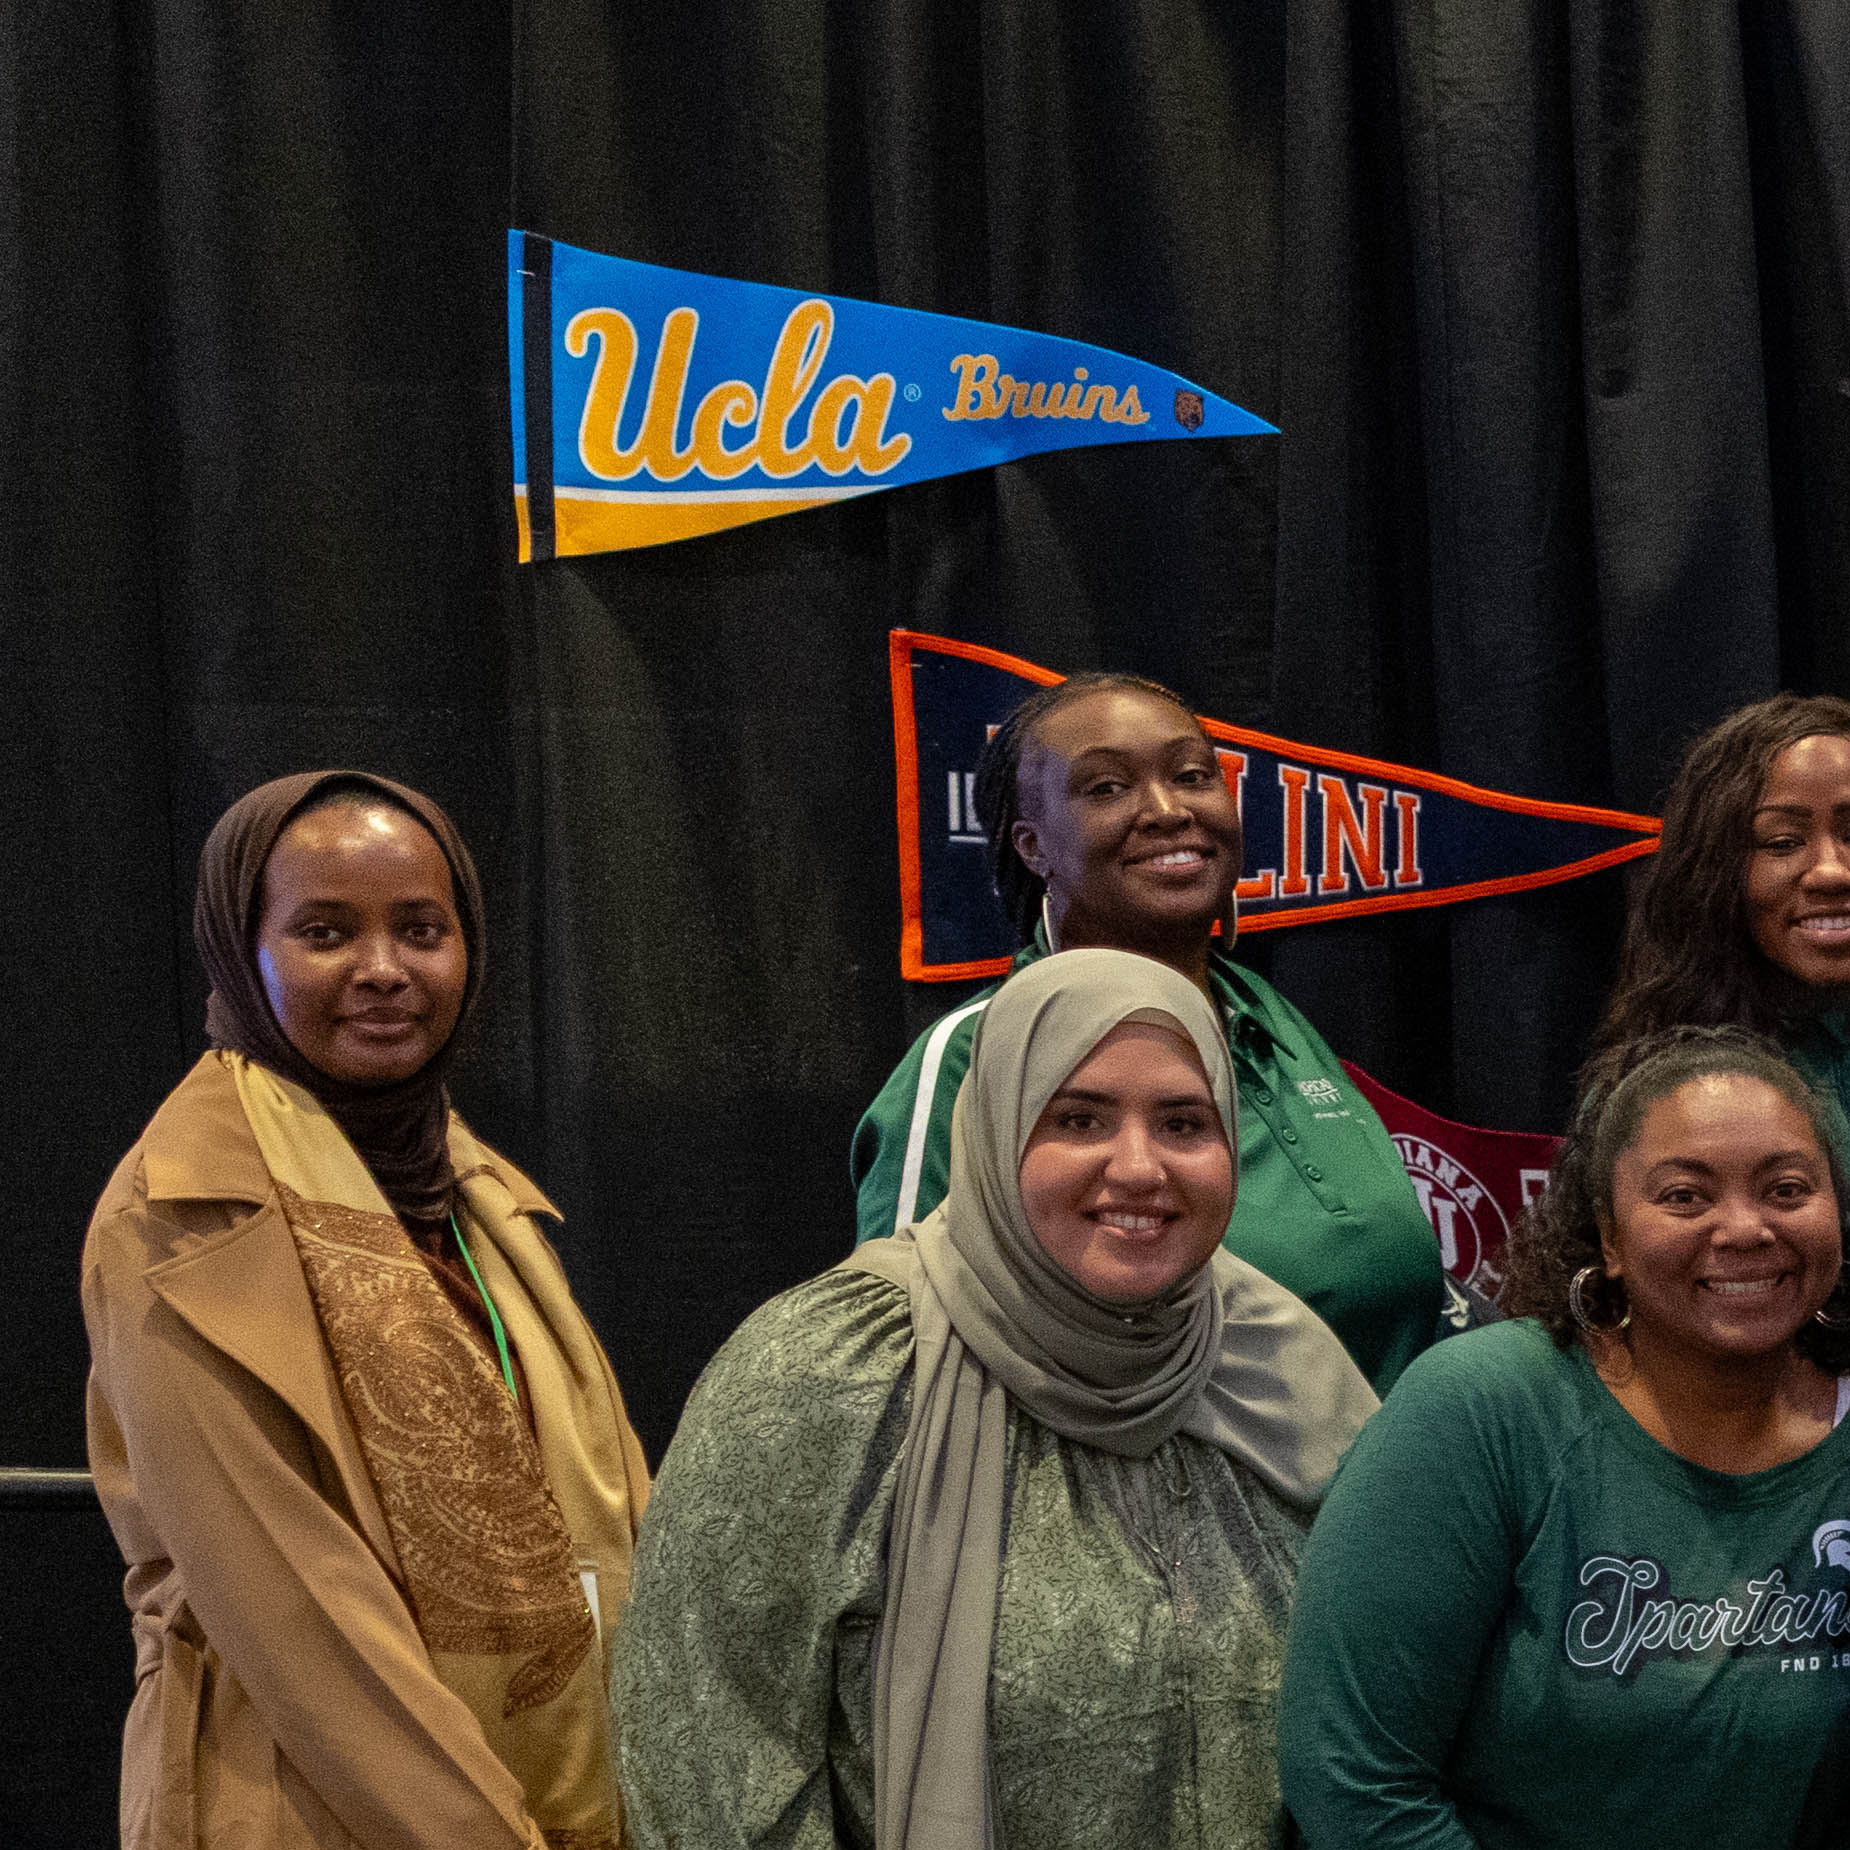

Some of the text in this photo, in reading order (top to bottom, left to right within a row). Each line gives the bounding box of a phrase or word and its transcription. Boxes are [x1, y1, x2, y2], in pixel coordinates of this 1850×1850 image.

[565, 299, 1150, 481] Ucla Bruins
[1214, 747, 1424, 900] LINI
[1781, 1657, 1820, 1672] FND
